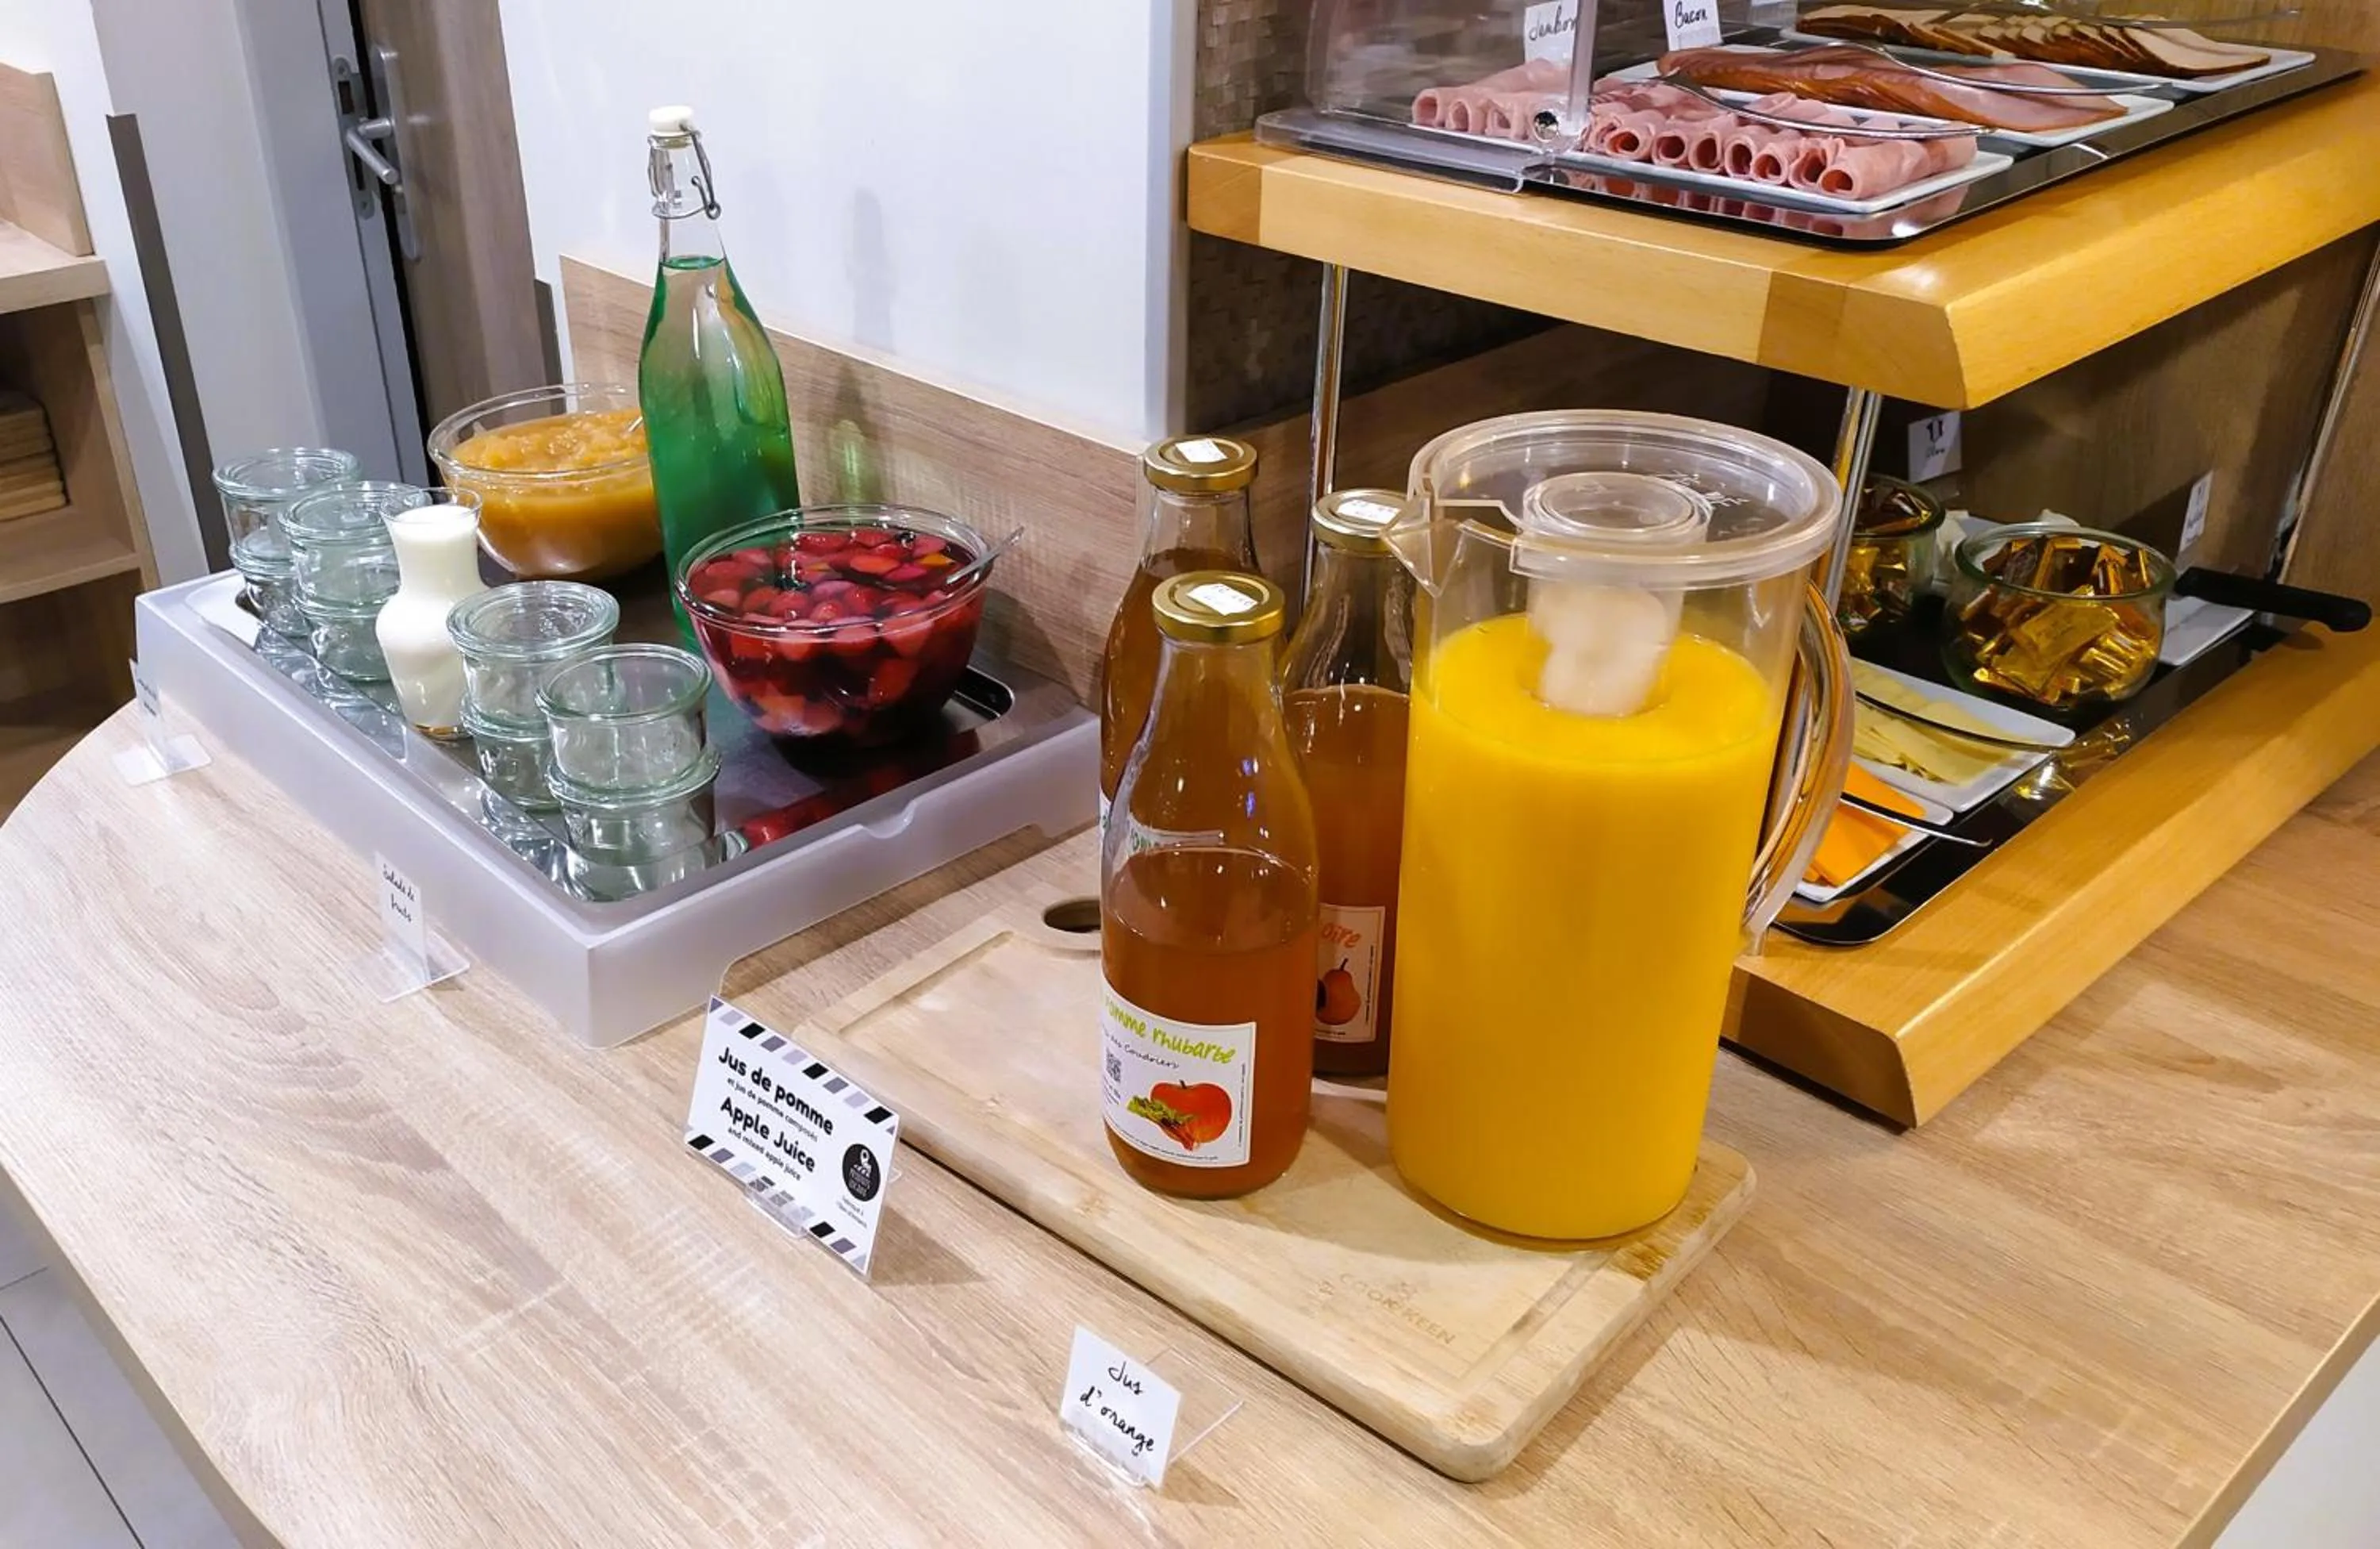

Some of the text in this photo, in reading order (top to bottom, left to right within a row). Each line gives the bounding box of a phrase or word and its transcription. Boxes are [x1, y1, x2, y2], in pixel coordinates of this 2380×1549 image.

[1675, 1, 1707, 29] Bacon
[1321, 922, 1361, 949] oire
[1153, 1027, 1236, 1064] rhubarbe
[718, 1047, 834, 1136] Jus de pomme
[720, 1097, 816, 1173] Apple Juice
[1107, 1360, 1143, 1395] Jus
